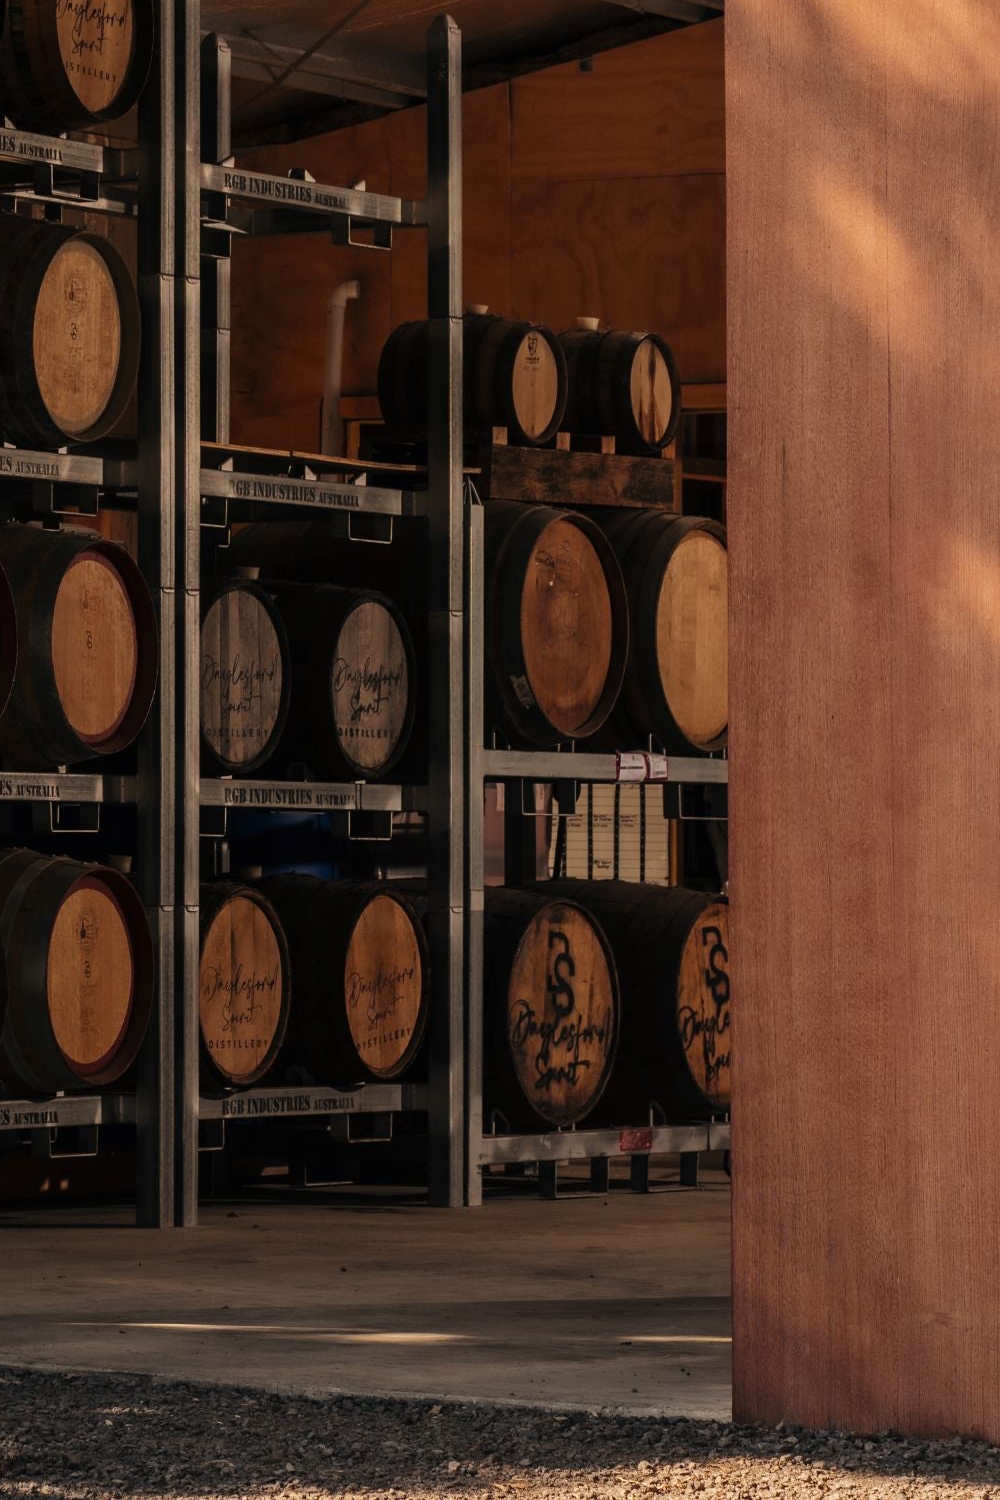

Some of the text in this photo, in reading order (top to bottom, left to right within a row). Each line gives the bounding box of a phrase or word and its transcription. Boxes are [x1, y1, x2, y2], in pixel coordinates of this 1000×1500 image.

[65, 61, 117, 83] ISTILLERY
[18, 141, 62, 161] AUSTRALIA
[224, 173, 247, 190] RGB
[249, 177, 312, 203] INDUSTRIES
[15, 461, 60, 477] AUSTRALIA
[253, 482, 316, 503] INDUSTRIES
[15, 784, 60, 798] AUSTRALIA
[224, 787, 357, 806] RGB INDUSTRIES AUSTRALI
[208, 1039, 268, 1049] DISTILLERY
[222, 1096, 354, 1116] RGB INDUSTRIES AUSTRALIA
[13, 1111, 59, 1125] AUSTRALIA
